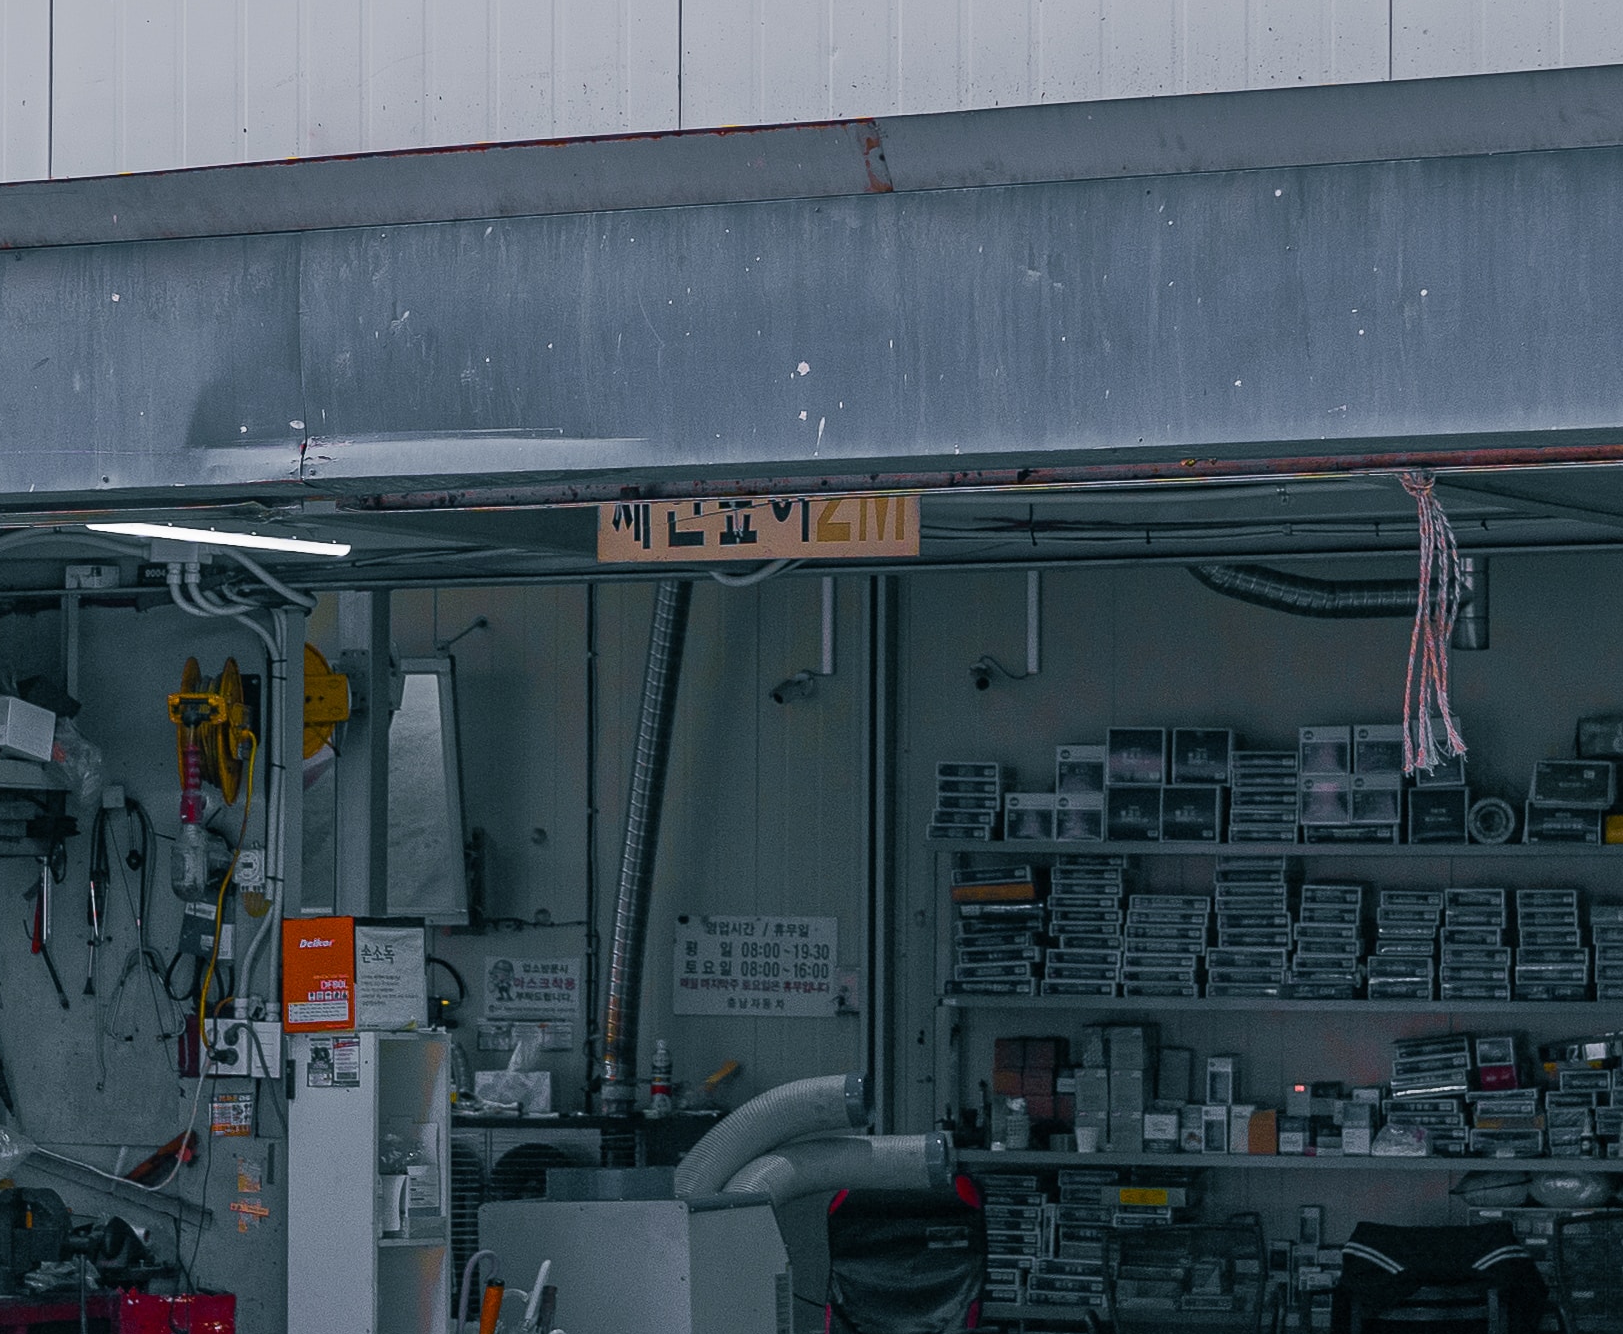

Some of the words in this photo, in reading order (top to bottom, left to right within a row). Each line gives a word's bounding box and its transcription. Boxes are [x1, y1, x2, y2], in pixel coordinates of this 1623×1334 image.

[705, 921, 755, 937] 영업시간
[773, 923, 809, 938] 휴무일
[360, 944, 395, 964] 손소독
